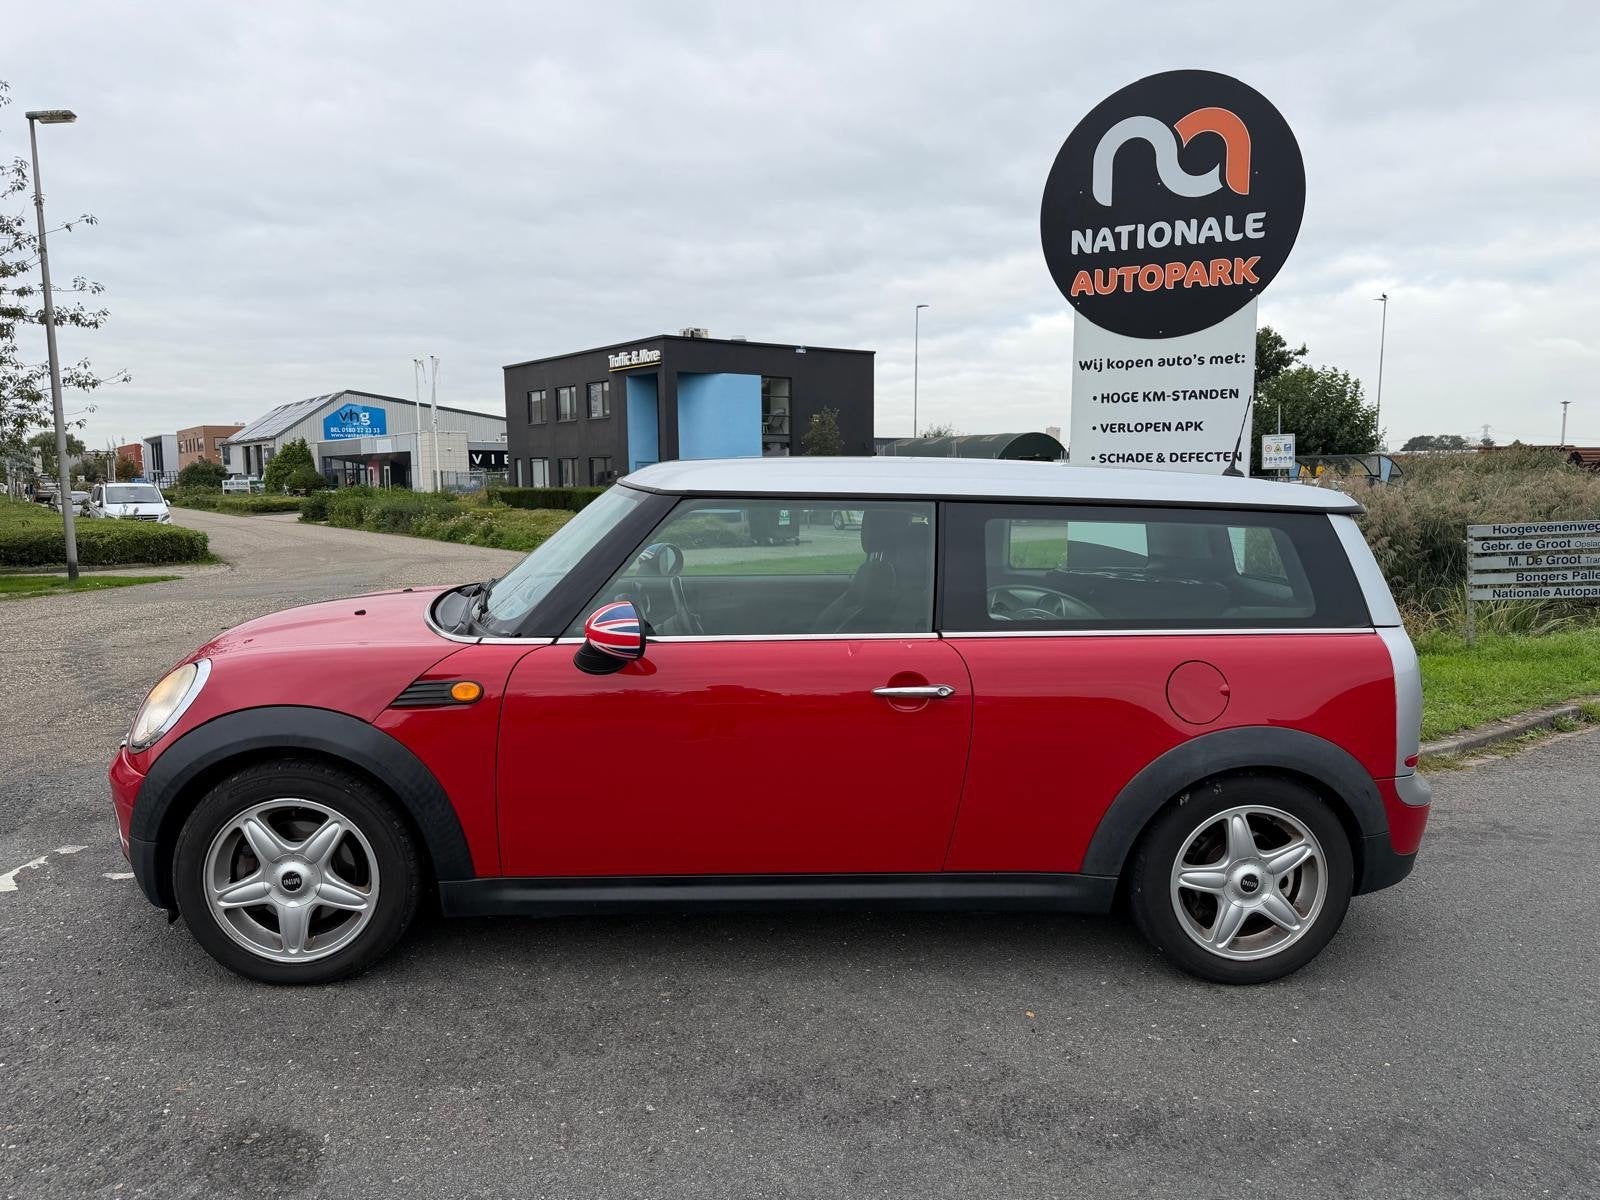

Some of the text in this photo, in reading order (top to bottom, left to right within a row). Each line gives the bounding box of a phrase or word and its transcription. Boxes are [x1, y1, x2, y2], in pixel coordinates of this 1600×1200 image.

[1071, 211, 1267, 255] NATIONALE
[1070, 256, 1261, 297] AUTOPARK
[608, 349, 661, 368] Traffic & More
[1078, 352, 1246, 373] Wij kopen auto's met:
[1100, 388, 1240, 404] HOGE KM-STANDEN
[339, 409, 370, 426] vhg
[1100, 420, 1204, 433] VERLOPEN APK
[1099, 451, 1242, 464] SCHADE & DEFECTEN
[1481, 541, 1514, 551] Gebr.
[1517, 540, 1533, 550] de
[1536, 539, 1571, 549] Groot
[1508, 556, 1522, 566] M.
[1526, 555, 1543, 566] De
[1546, 554, 1581, 565] Groot
[1516, 572, 1568, 583] Bongers
[1492, 587, 1551, 599] Nationale
